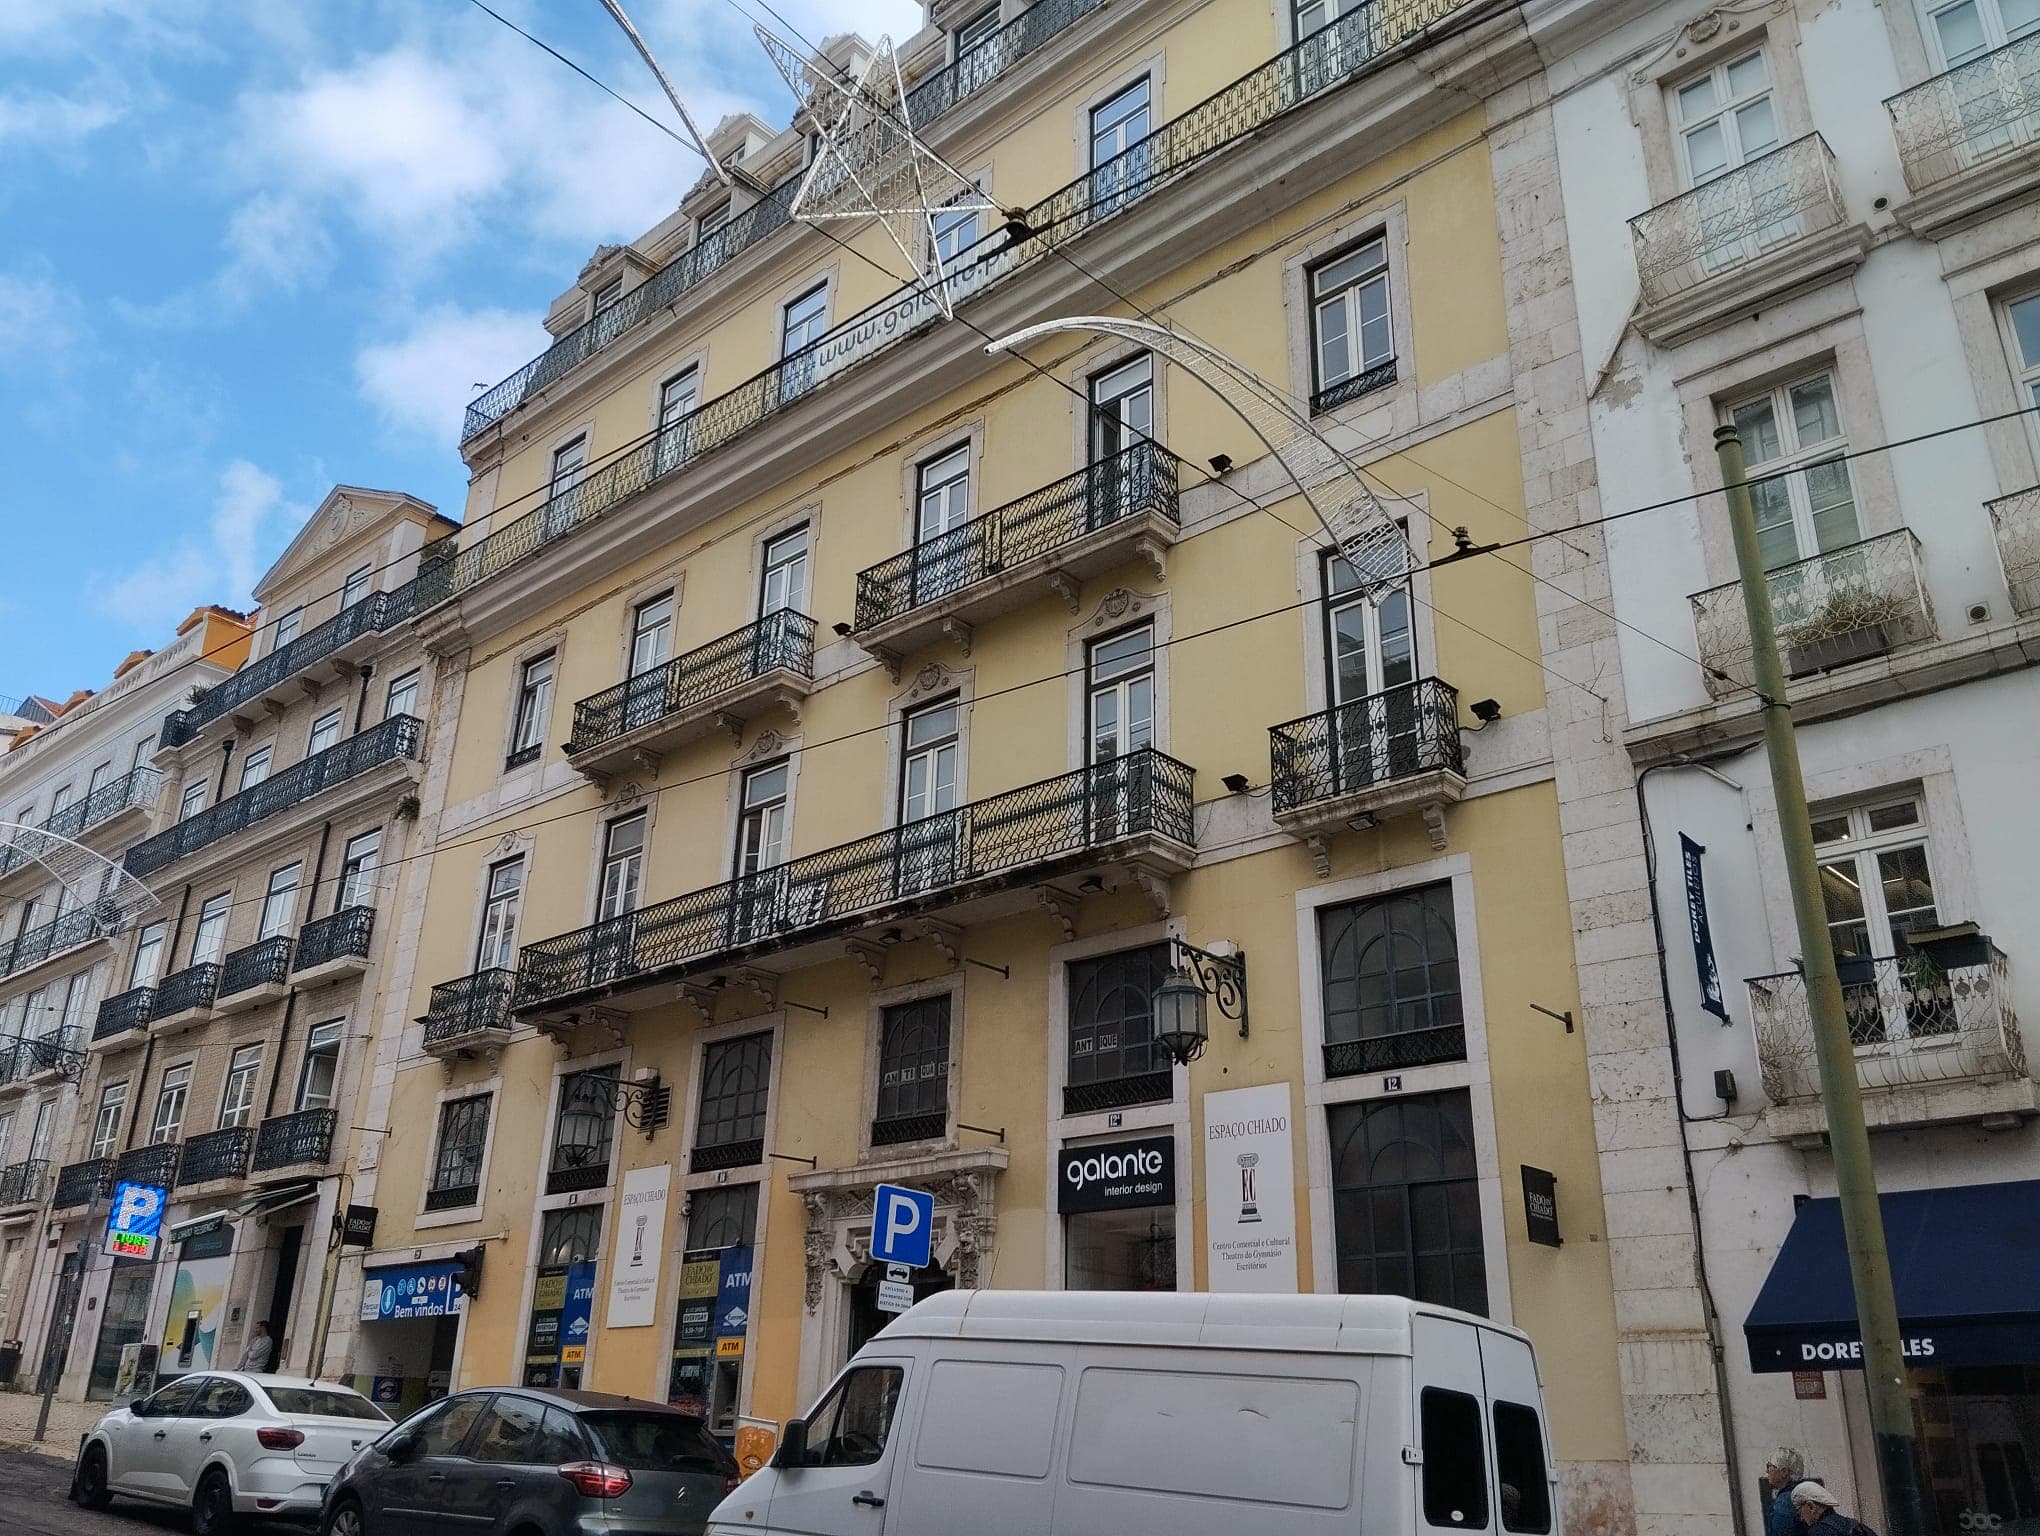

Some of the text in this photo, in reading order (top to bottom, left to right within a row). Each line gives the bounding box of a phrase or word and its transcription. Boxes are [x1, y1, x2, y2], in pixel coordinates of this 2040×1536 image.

[1685, 851, 1693, 887] TILES
[1209, 1116, 1287, 1141] ESPAÇO CHIADO
[1067, 1148, 1163, 1191] galante
[1104, 1181, 1163, 1197] interior design
[116, 1186, 159, 1230] P
[885, 1193, 920, 1254] P
[726, 1271, 752, 1288] ATM
[394, 1303, 443, 1318] Bem vindos
[566, 1351, 581, 1360] ATM
[721, 1342, 739, 1351] ATM
[1801, 1341, 1864, 1361] DORE
